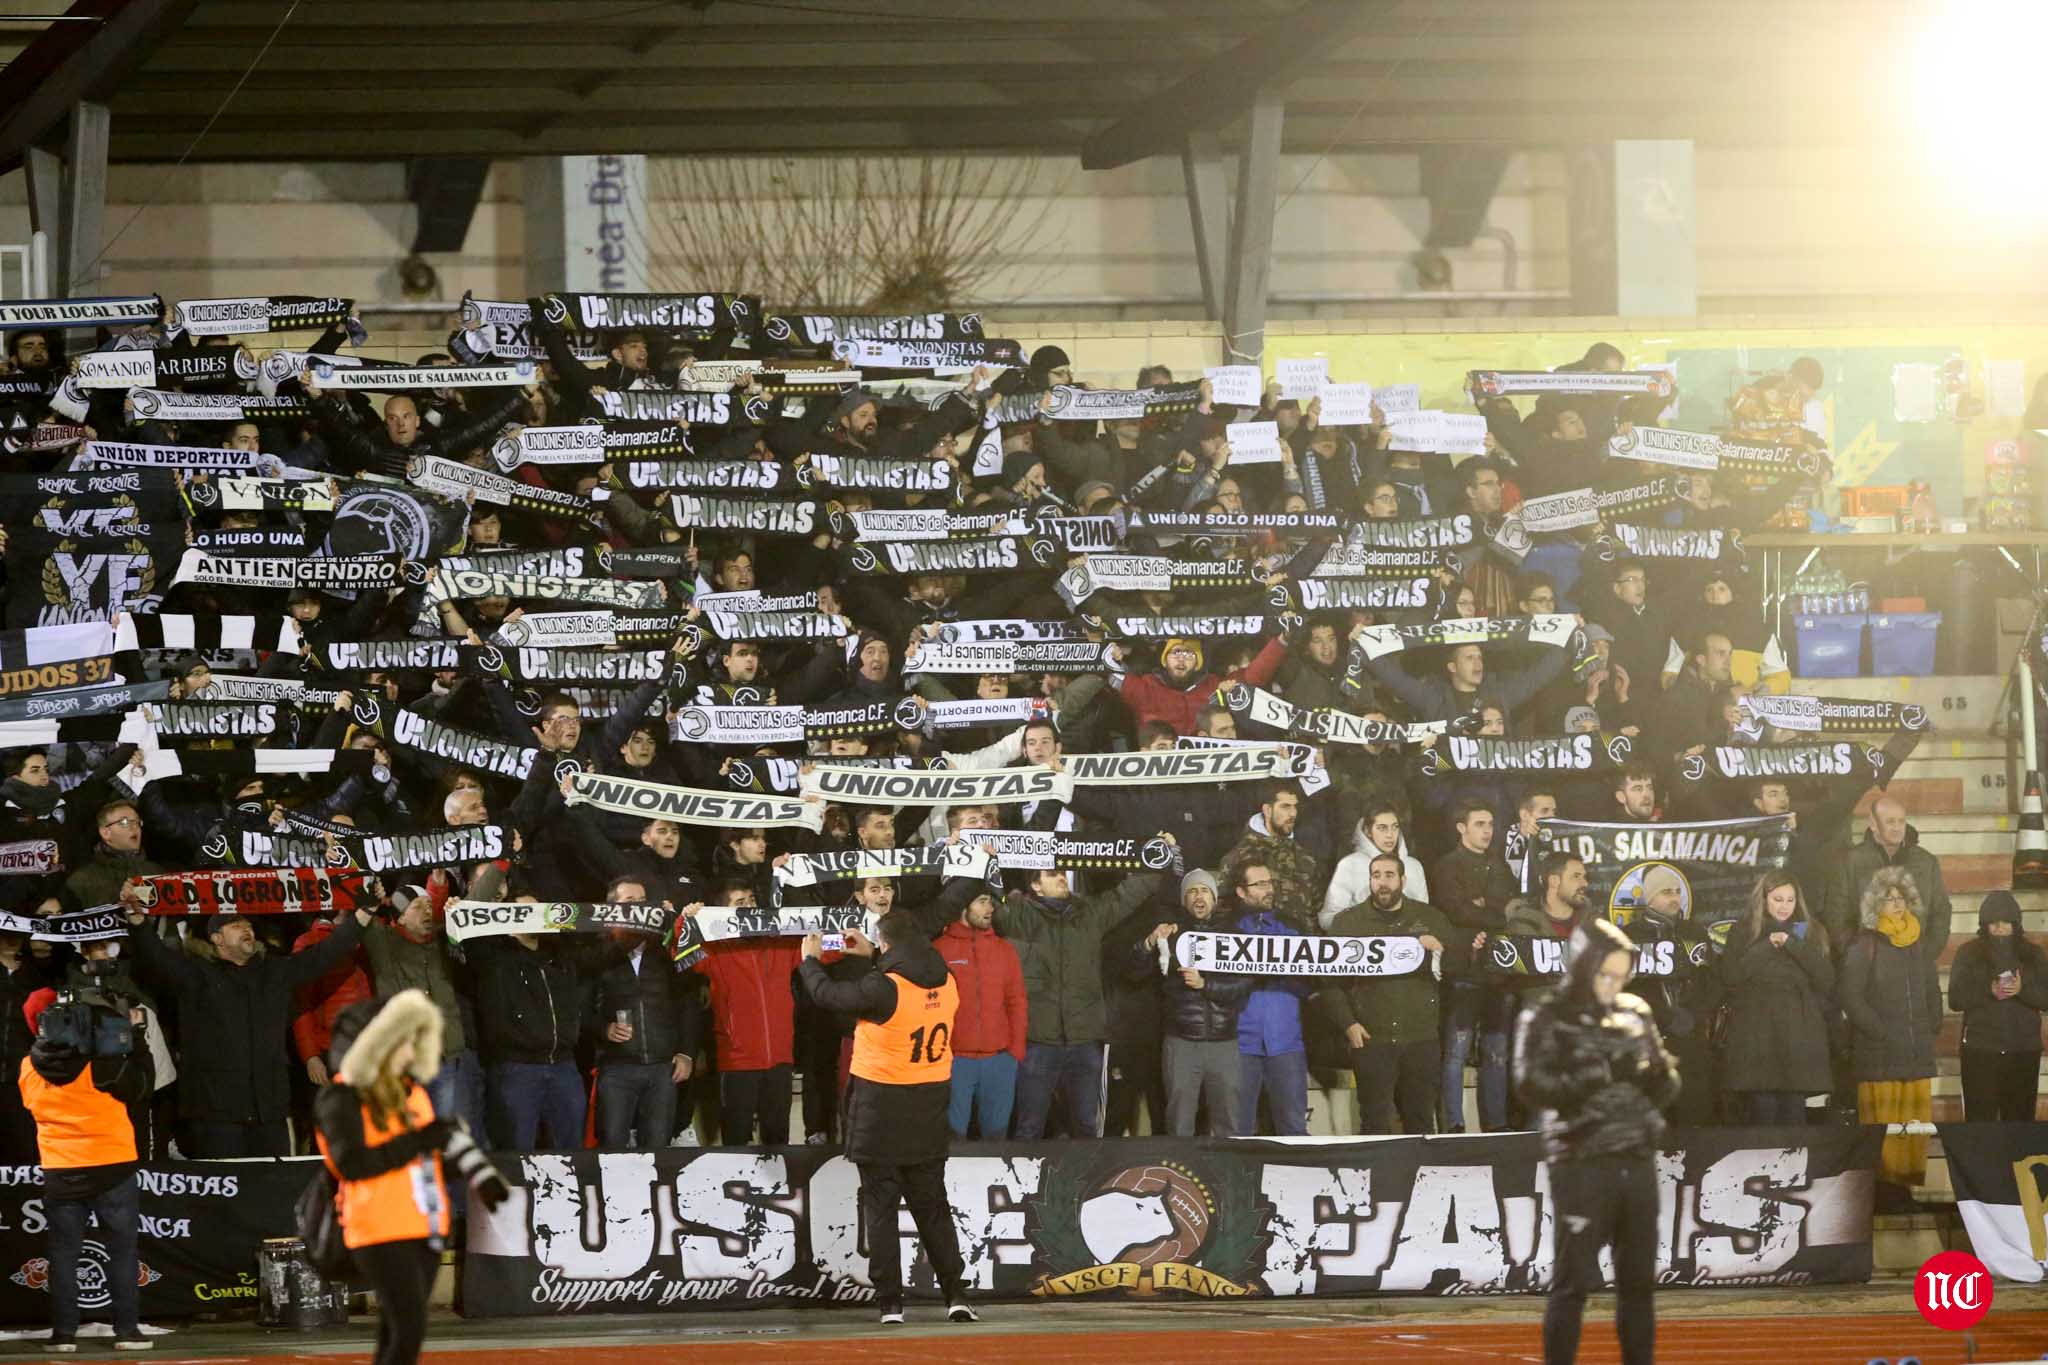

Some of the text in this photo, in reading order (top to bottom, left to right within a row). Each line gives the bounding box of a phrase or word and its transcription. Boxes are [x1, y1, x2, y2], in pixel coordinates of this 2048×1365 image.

[6, 301, 159, 322] YOUR LOCAL TEAM
[189, 302, 249, 322] UNIONISTAS
[579, 294, 717, 330] UNIONISTAS
[803, 313, 945, 347] UNIONISTAS
[78, 360, 153, 379] KOMANDO
[157, 356, 227, 376] ARRIBES
[341, 371, 510, 385] UNIONISTAS DE SALAMANCA CF
[597, 392, 731, 425] UNIONISTAS
[523, 430, 585, 451] UNIONISTAS
[599, 427, 660, 449] Salamanca
[94, 444, 252, 468] UNIÓN DEPORTIVA
[629, 461, 782, 492] UNIONISTAS
[810, 453, 950, 492] UNIONISTAS
[671, 494, 816, 533] UNIONISTAS
[862, 513, 927, 532] UNIONISTAS
[1205, 513, 1249, 526] SOLO
[1253, 514, 1299, 527] HUBO
[1303, 514, 1338, 527] UNA
[215, 531, 306, 548] HUBO UNA
[197, 558, 397, 586] ANTIENGENDRO
[885, 541, 1019, 575] UNIONISTAS
[1090, 558, 1151, 577] UNIONISTAS
[1166, 558, 1226, 577] Salamanca
[193, 573, 214, 584] SOLO
[216, 575, 226, 584] EL
[226, 576, 258, 587] BLANCO
[266, 580, 294, 589] NEGRO
[1299, 578, 1431, 611] UNIONISTAS
[705, 610, 848, 643] UNIONISTAS
[84, 658, 113, 684] 37
[518, 647, 666, 682] UNIONISTAS
[715, 703, 888, 731] UNIONISTAS de Salamanca C.F.
[1450, 734, 1593, 771] UNIONISTAS
[1714, 741, 1853, 780] UNIONISTAS
[819, 771, 1058, 804] UNIONISTAS
[363, 824, 504, 873] UNIONISTAS
[1050, 837, 1115, 859] Salamanca
[1114, 841, 1136, 859] C.F.
[1614, 830, 1761, 867] SALAMANCA
[450, 904, 535, 929] USCF
[590, 903, 666, 929] FANS
[1215, 962, 1385, 978] UNIONISTAS DE SALAMANCA
[909, 1021, 950, 1064] 10
[531, 1268, 665, 1312] Support
[663, 1281, 739, 1306] your
